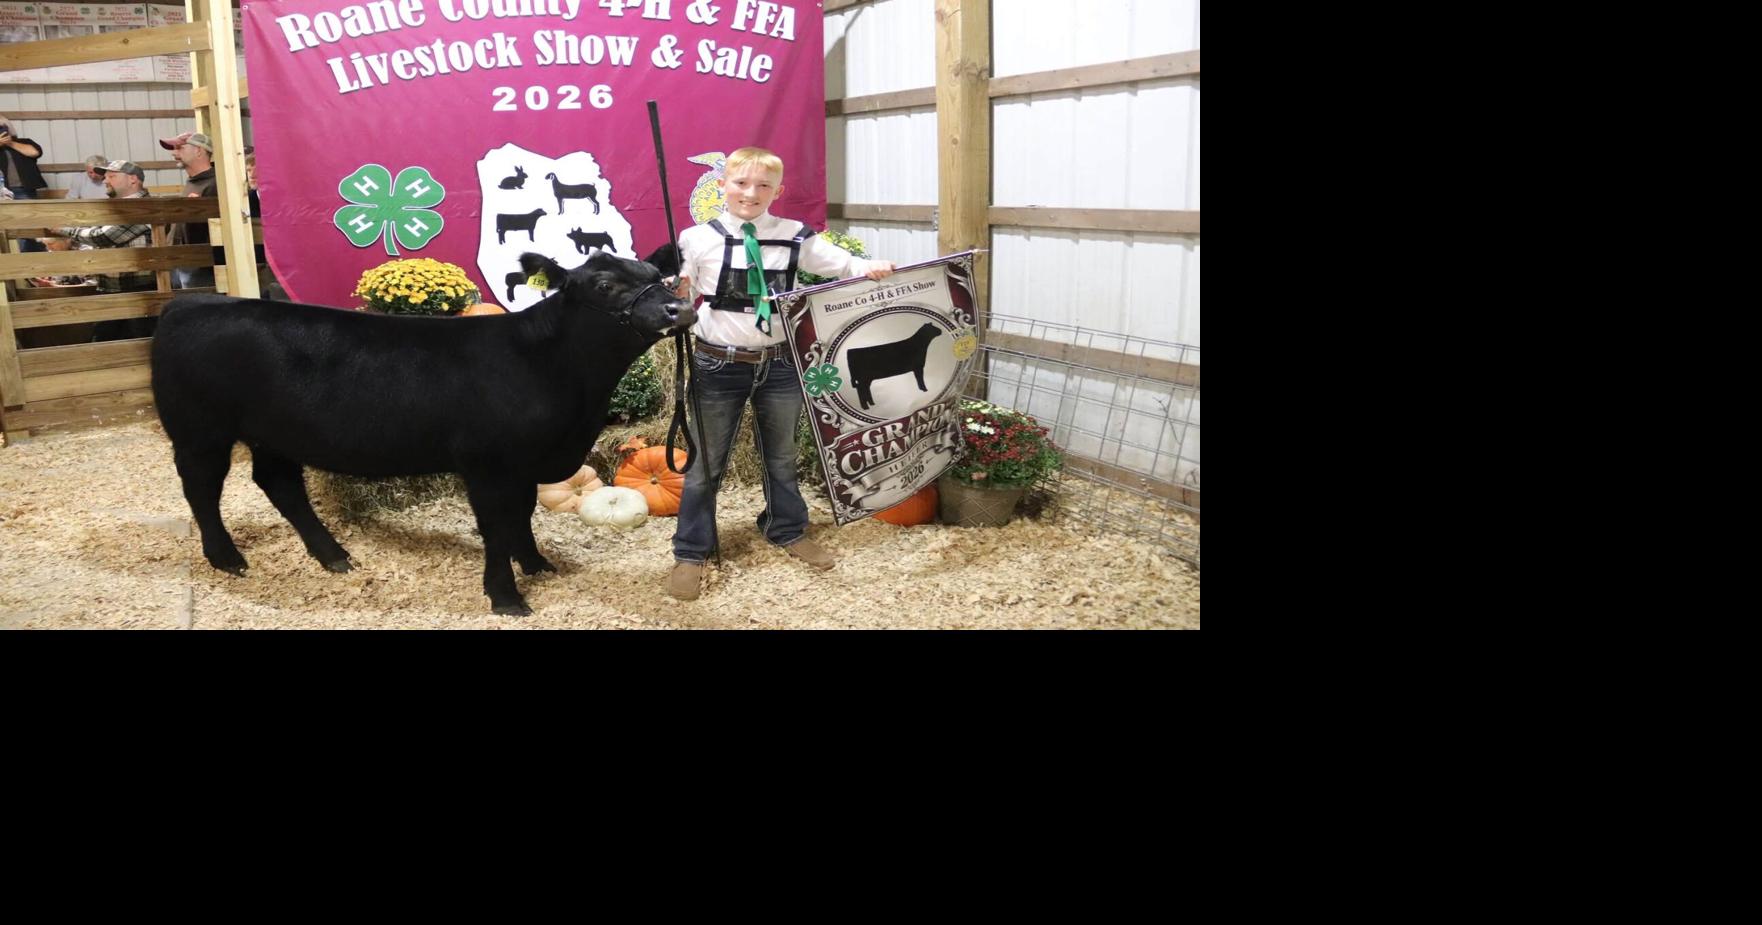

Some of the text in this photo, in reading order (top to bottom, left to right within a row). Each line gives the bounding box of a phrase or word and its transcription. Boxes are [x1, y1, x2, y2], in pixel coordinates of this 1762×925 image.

[276, 0, 426, 52] Roane
[686, 0, 721, 25] &
[731, 0, 796, 41] FFA
[327, 30, 773, 94] Livestock Show & Sale
[492, 85, 614, 111] 2026
[353, 175, 380, 197] H
[405, 178, 431, 198] H
[348, 213, 374, 234] H
[403, 217, 430, 238] H
[824, 280, 936, 313] Roane Co 4-H & FFA Show
[807, 371, 817, 380] H
[824, 366, 833, 375] H
[810, 384, 819, 392] H
[829, 379, 839, 388] H
[862, 403, 946, 448] GRAND
[900, 464, 925, 489] 2026
